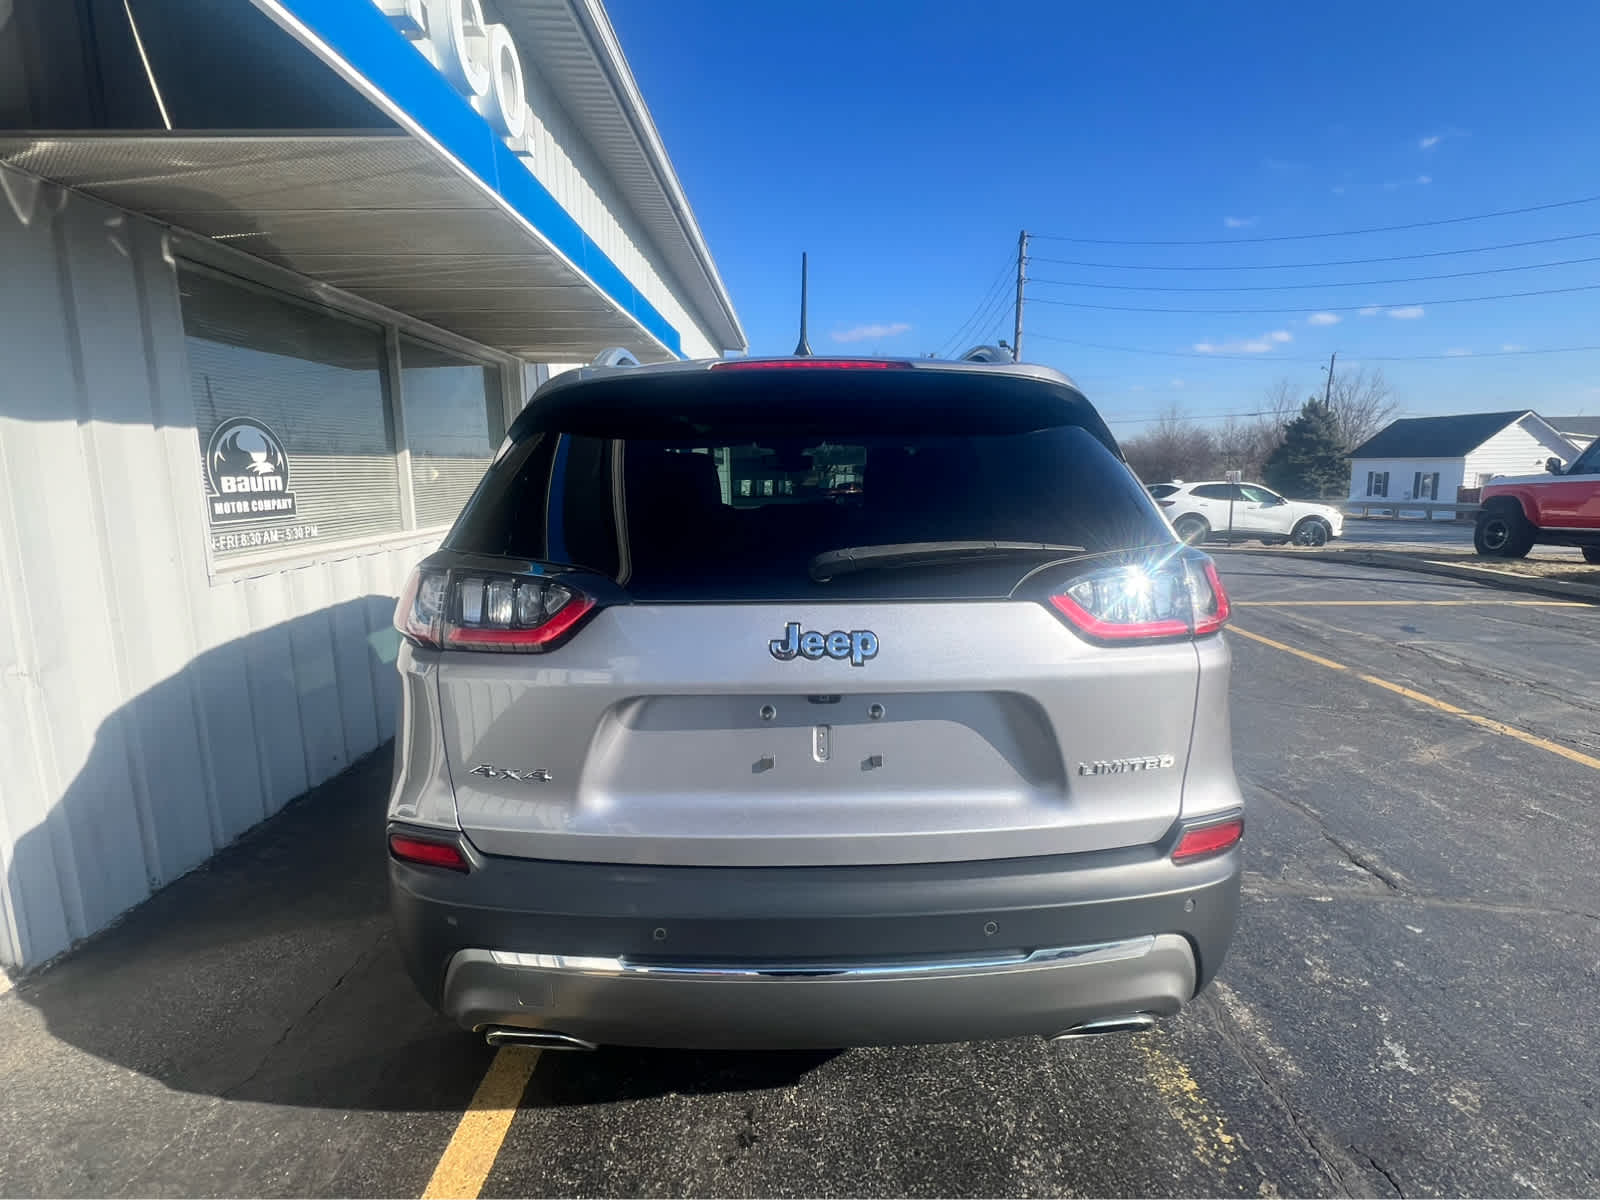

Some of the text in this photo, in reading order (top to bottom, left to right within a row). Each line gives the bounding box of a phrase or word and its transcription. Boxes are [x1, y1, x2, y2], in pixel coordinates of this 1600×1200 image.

[220, 475, 283, 493] Baum
[213, 498, 292, 515] MOTOR COMPANY
[240, 532, 261, 547] 8:30
[262, 529, 279, 544] AM
[304, 524, 319, 538] PM
[768, 622, 879, 667] Jeep
[1078, 753, 1175, 776] LIMITED
